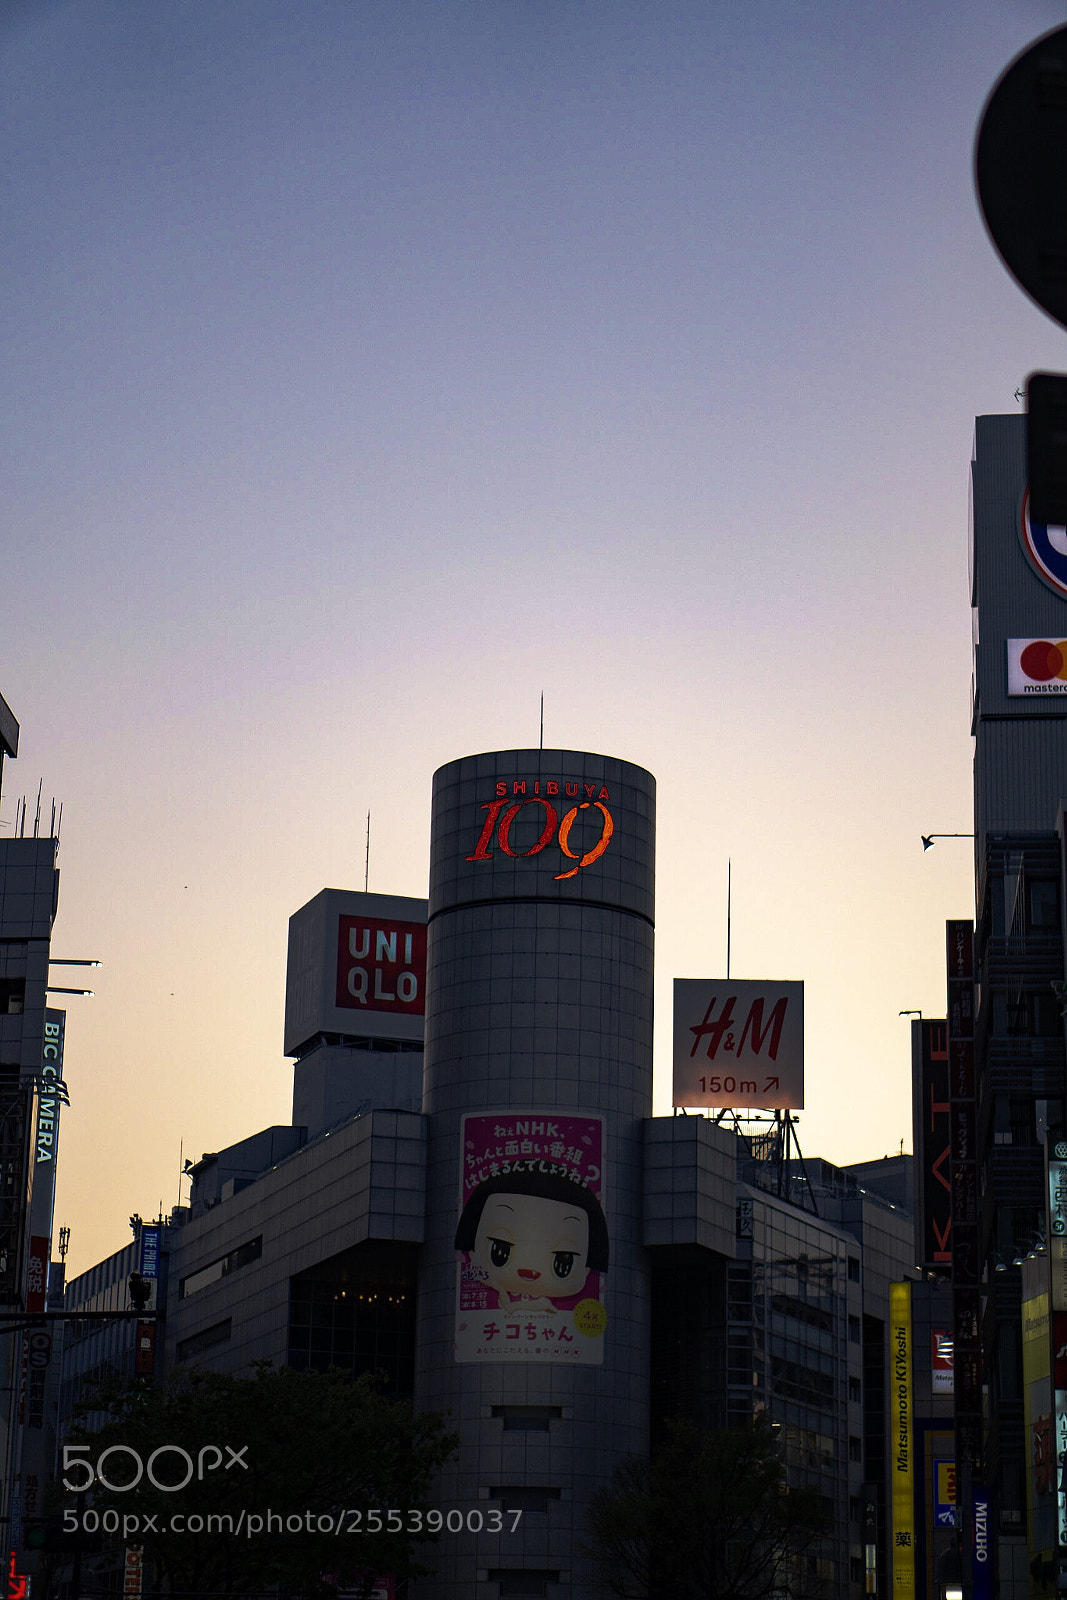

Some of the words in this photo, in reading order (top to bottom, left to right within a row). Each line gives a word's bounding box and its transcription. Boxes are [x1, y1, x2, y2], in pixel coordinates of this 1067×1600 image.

[495, 780, 610, 801] SHIBUYA
[465, 797, 615, 880] 109
[348, 926, 413, 965] UNI
[346, 970, 418, 1004] QLO
[43, 1022, 60, 1060] BIC
[690, 996, 788, 1061] H&M
[698, 1076, 757, 1093] 150m
[36, 1065, 58, 1164] CAMERA
[494, 1121, 566, 1138] ねぇNHK、
[466, 1138, 584, 1169] ちゃんと面白い番組
[29, 1256, 43, 1293] 免税
[483, 1321, 573, 1341] チコちゃん
[896, 1326, 908, 1382] KiYoshi
[896, 1384, 908, 1473] Matsumoto
[975, 1502, 989, 1563] MIZUHO
